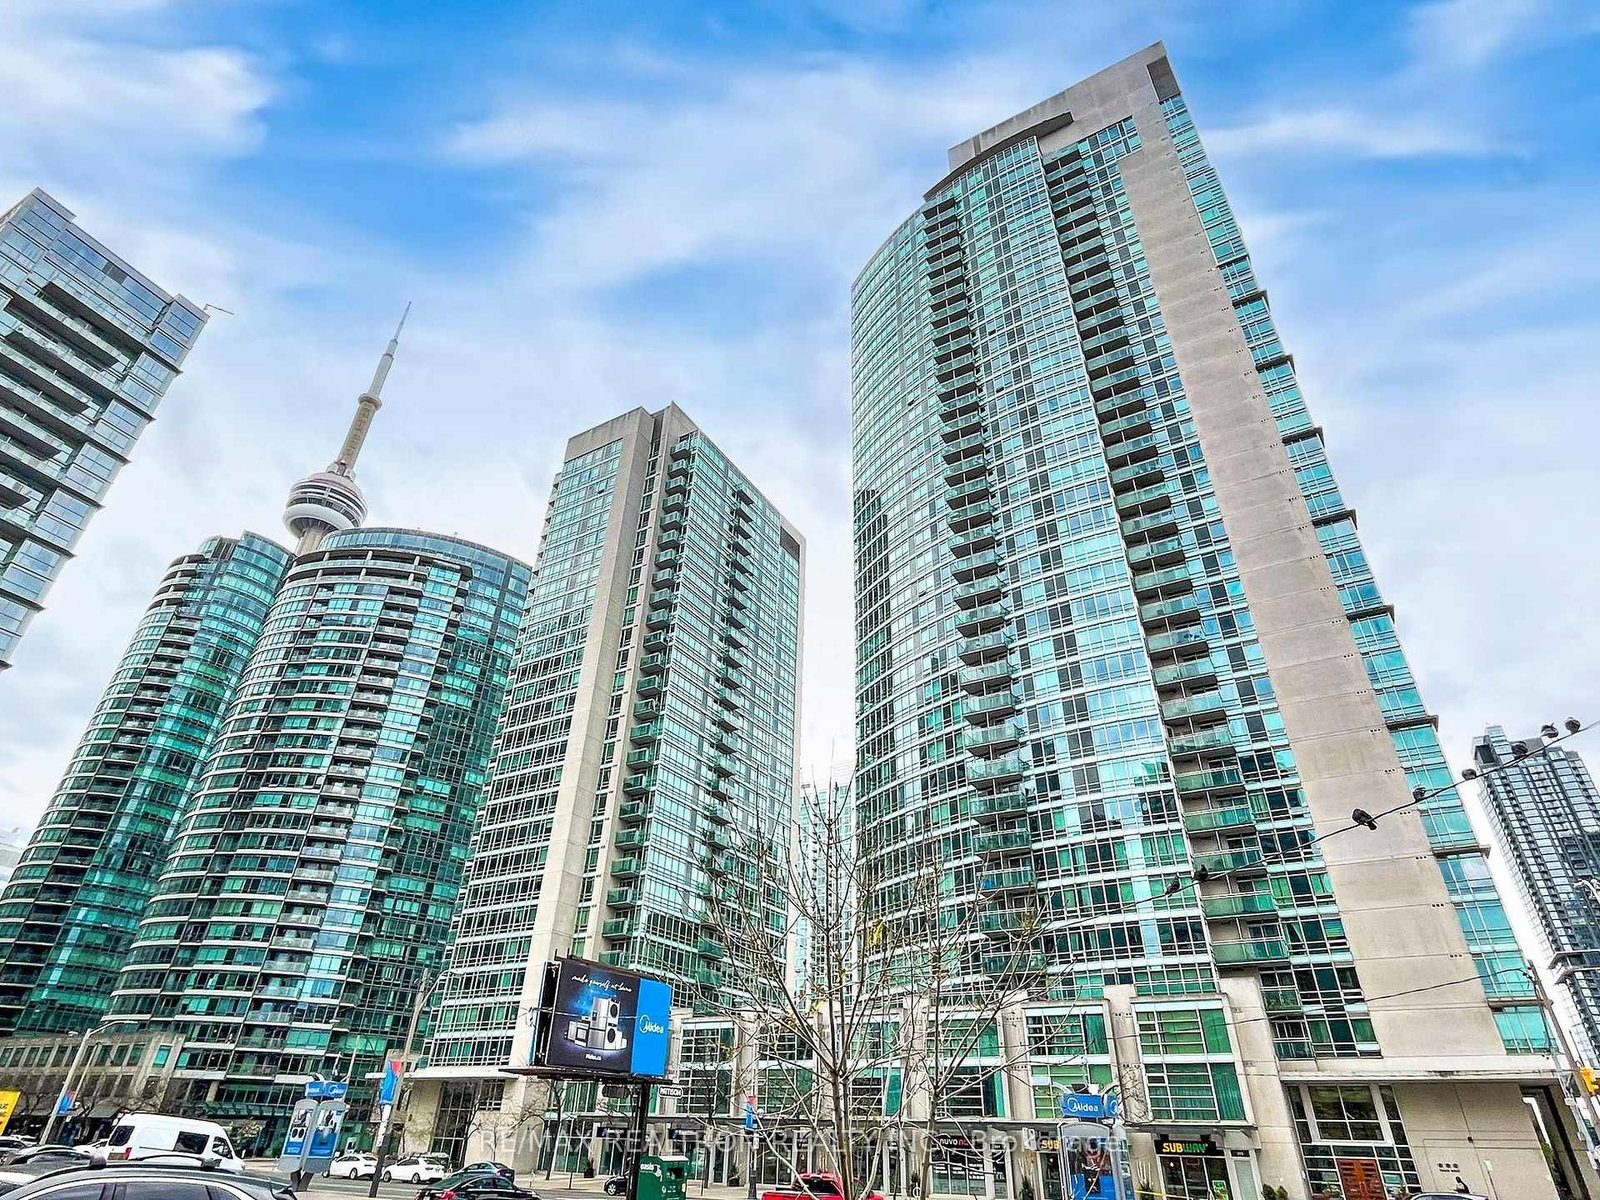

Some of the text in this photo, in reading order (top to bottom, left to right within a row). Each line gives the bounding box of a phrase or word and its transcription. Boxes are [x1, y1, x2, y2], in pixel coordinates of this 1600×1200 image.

[639, 1014, 665, 1034] Midea
[1067, 1097, 1099, 1113] Midea
[1162, 1142, 1206, 1153] SUBWAY
